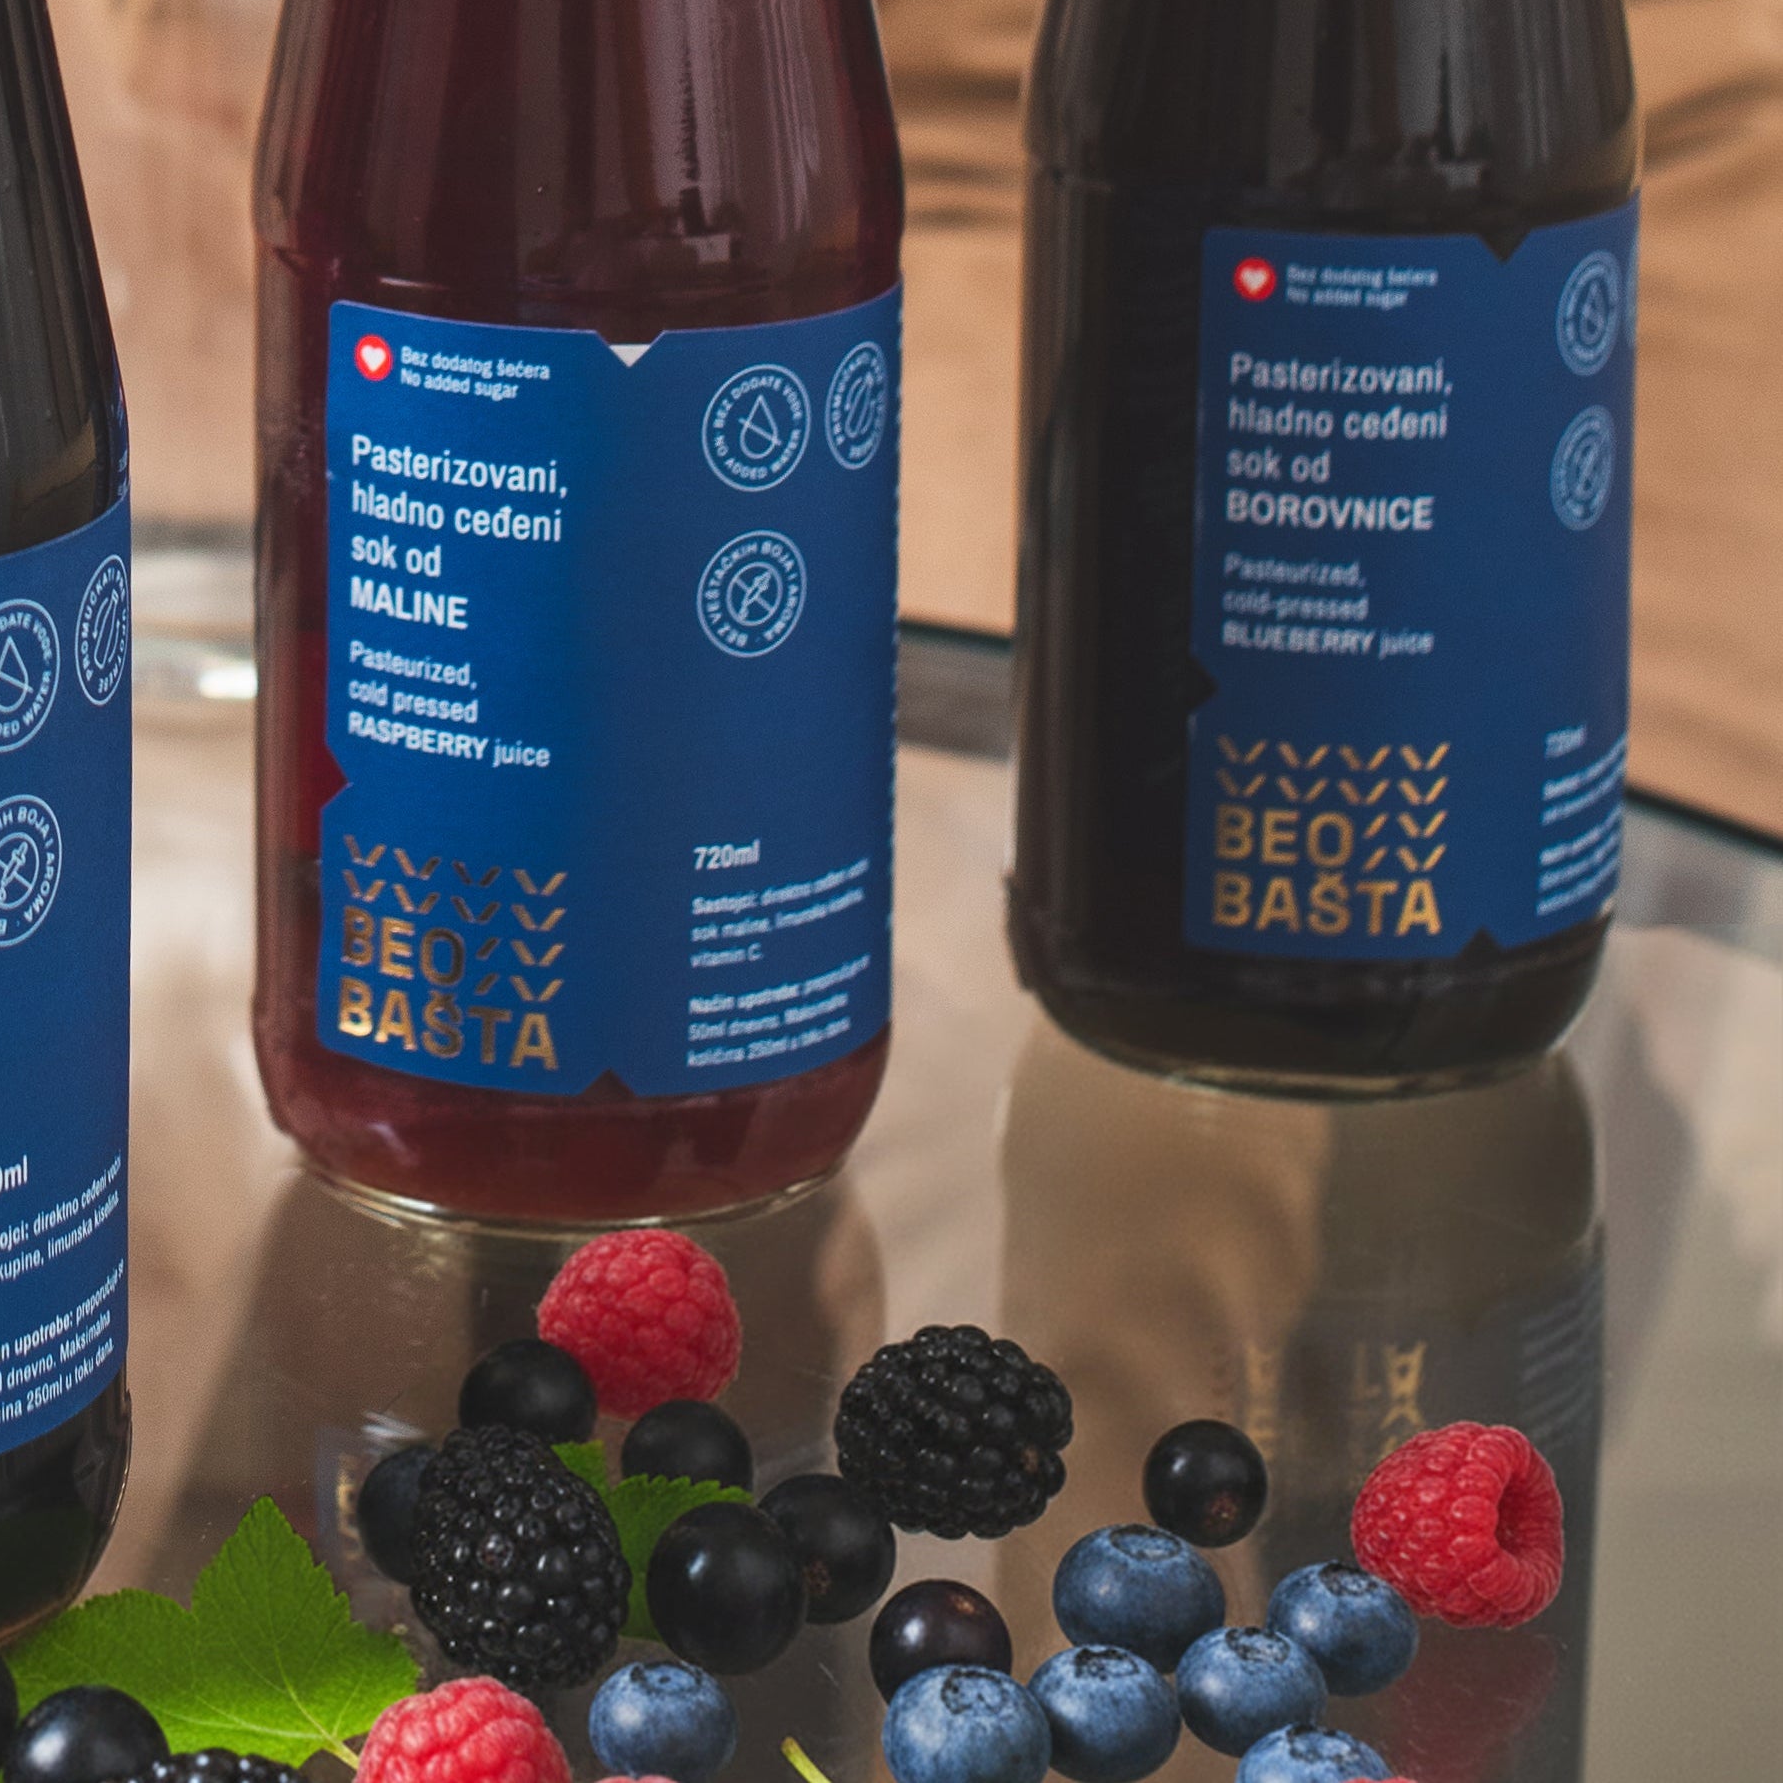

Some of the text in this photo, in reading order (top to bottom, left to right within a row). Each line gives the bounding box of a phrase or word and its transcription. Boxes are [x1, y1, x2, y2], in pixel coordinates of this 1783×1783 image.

[400, 346, 428, 366] Bez
[431, 350, 493, 379] dodatog
[400, 368, 519, 401] No added sugar
[1230, 352, 1453, 396] Pasterizovani,
[1228, 396, 1333, 439] hladno
[352, 434, 568, 499] Pasterizovani,
[1227, 446, 1331, 483] sok od
[352, 479, 562, 542] hladno ceđeni
[1226, 489, 1435, 531] BOROVNICE
[351, 535, 442, 578] sok od
[350, 576, 468, 630] MALINE
[1222, 620, 1376, 655] BLUEBERRY
[349, 640, 477, 690] Pasteurized,
[22, 670, 52, 726] WATER
[348, 679, 479, 724] cold pressed
[347, 711, 551, 768] RASPBERRY juice
[17, 805, 50, 839] BOJA
[1216, 804, 1354, 868] BEO
[694, 838, 761, 870] 720ml
[23, 852, 56, 922] AROMA
[1214, 870, 1442, 937] BAŠTA
[342, 905, 463, 986] BEO
[339, 976, 558, 1070] BAŠTA
[33, 1197, 79, 1237] direktno
[48, 1216, 93, 1260] limunska
[14, 1310, 73, 1357] upotrebe:
[7, 1353, 57, 1390] dnevno.
[26, 1374, 63, 1412] 250ml
[65, 1374, 73, 1391] u
[74, 1355, 94, 1385] toku
